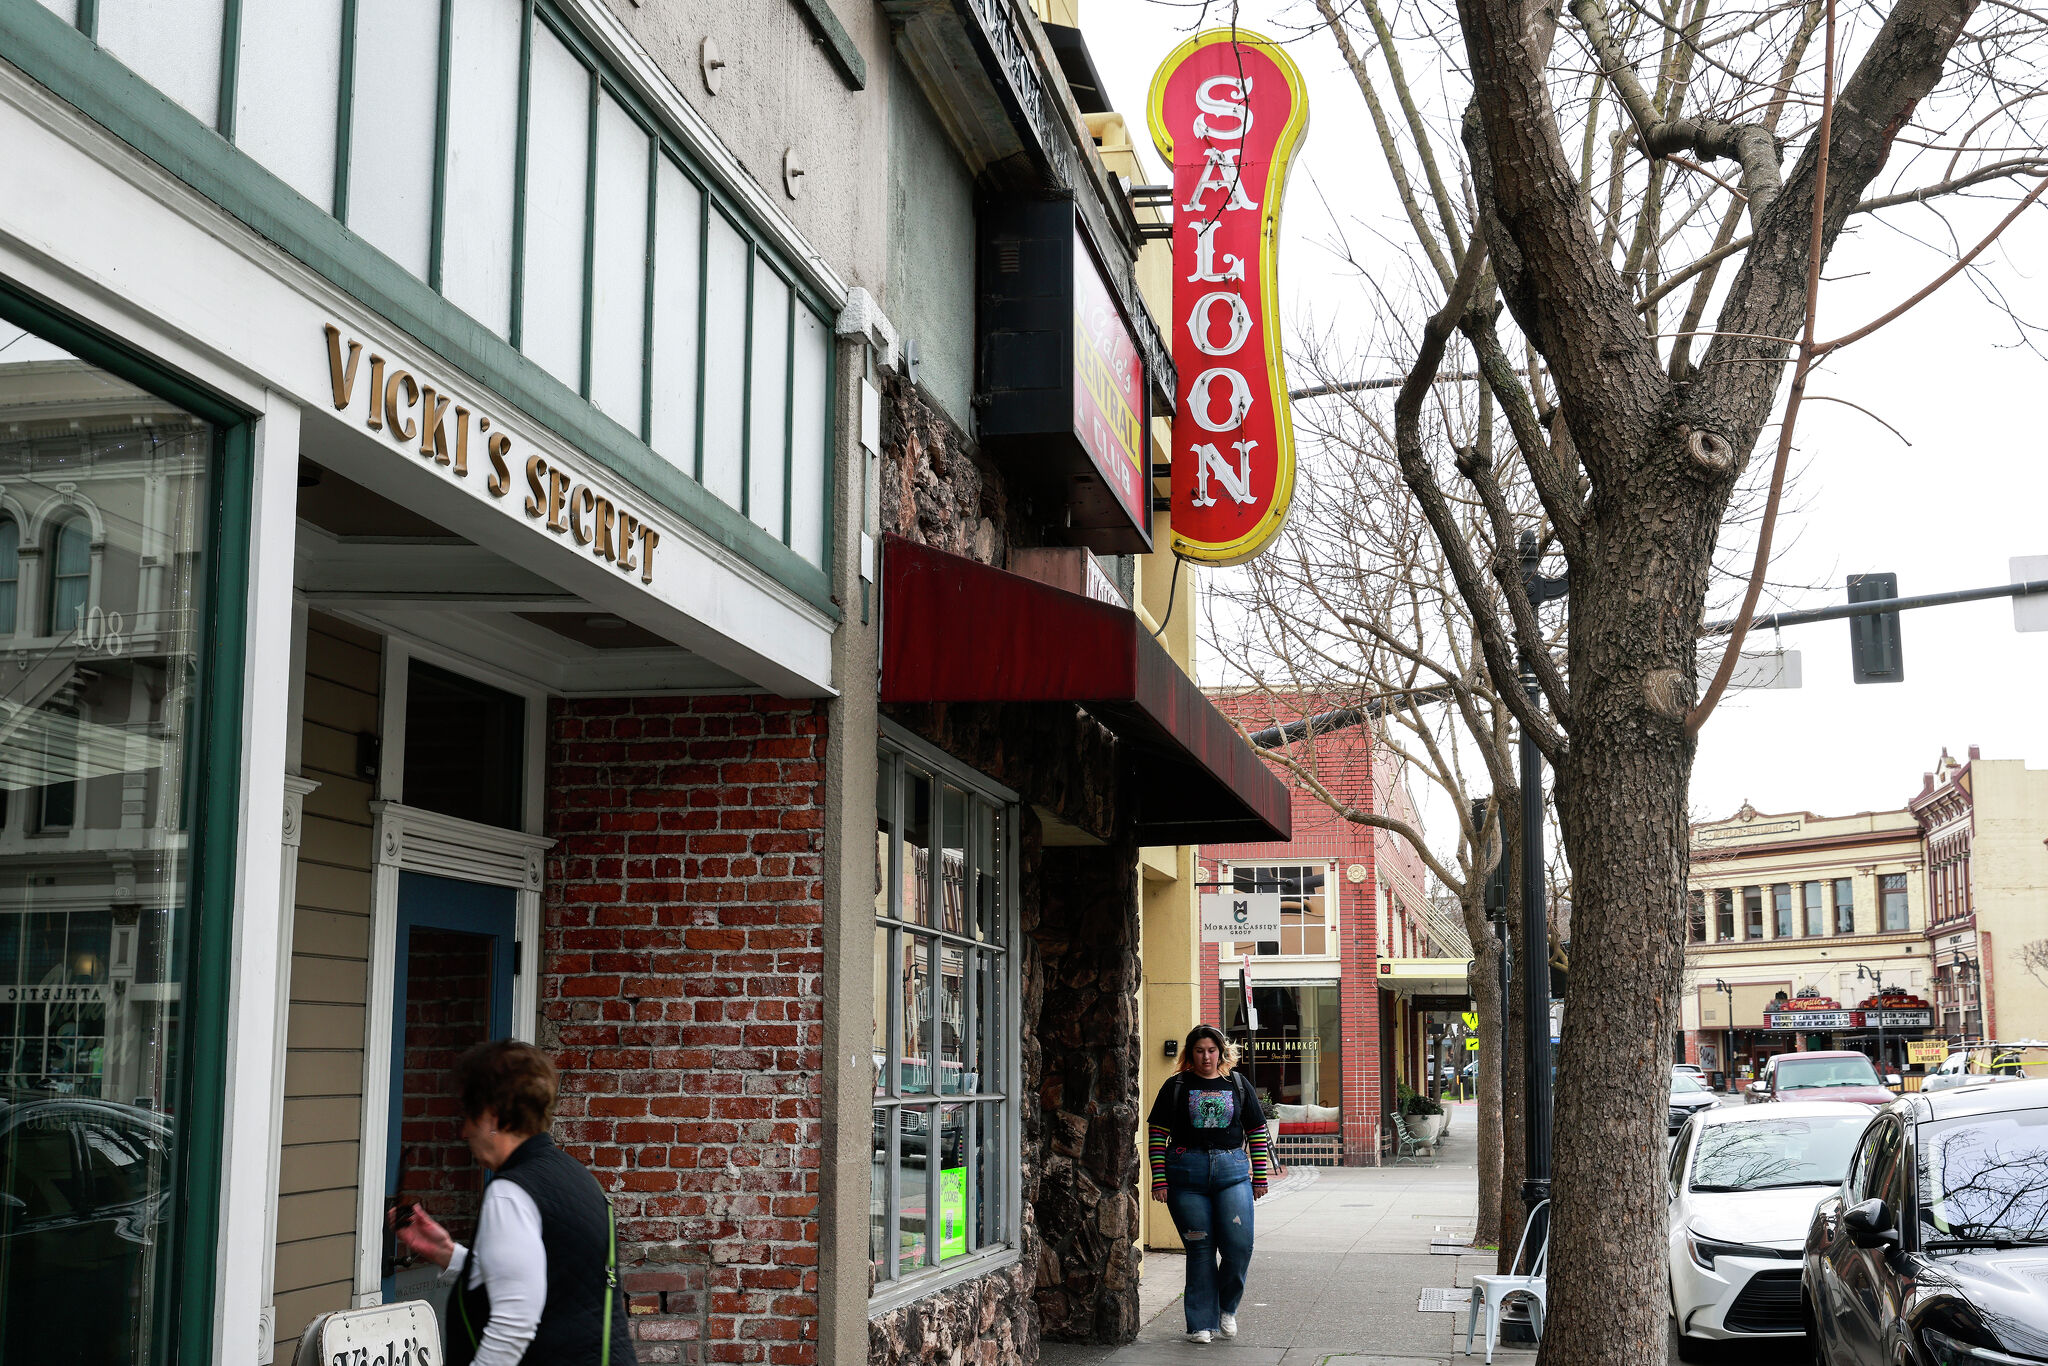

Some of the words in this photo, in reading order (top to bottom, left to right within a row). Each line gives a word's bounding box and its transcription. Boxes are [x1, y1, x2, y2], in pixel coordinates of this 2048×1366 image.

[1182, 74, 1259, 507] SALOON
[1076, 327, 1136, 457] CENTRAL
[324, 322, 512, 498] VICKI'S
[524, 454, 660, 585] SECRET
[1093, 414, 1131, 496] CLUB
[72, 602, 123, 656] 108
[912, 1051, 960, 1087] BARERS
[1244, 1041, 1281, 1051] CNTRAL
[1285, 1041, 1318, 1051] MARKET
